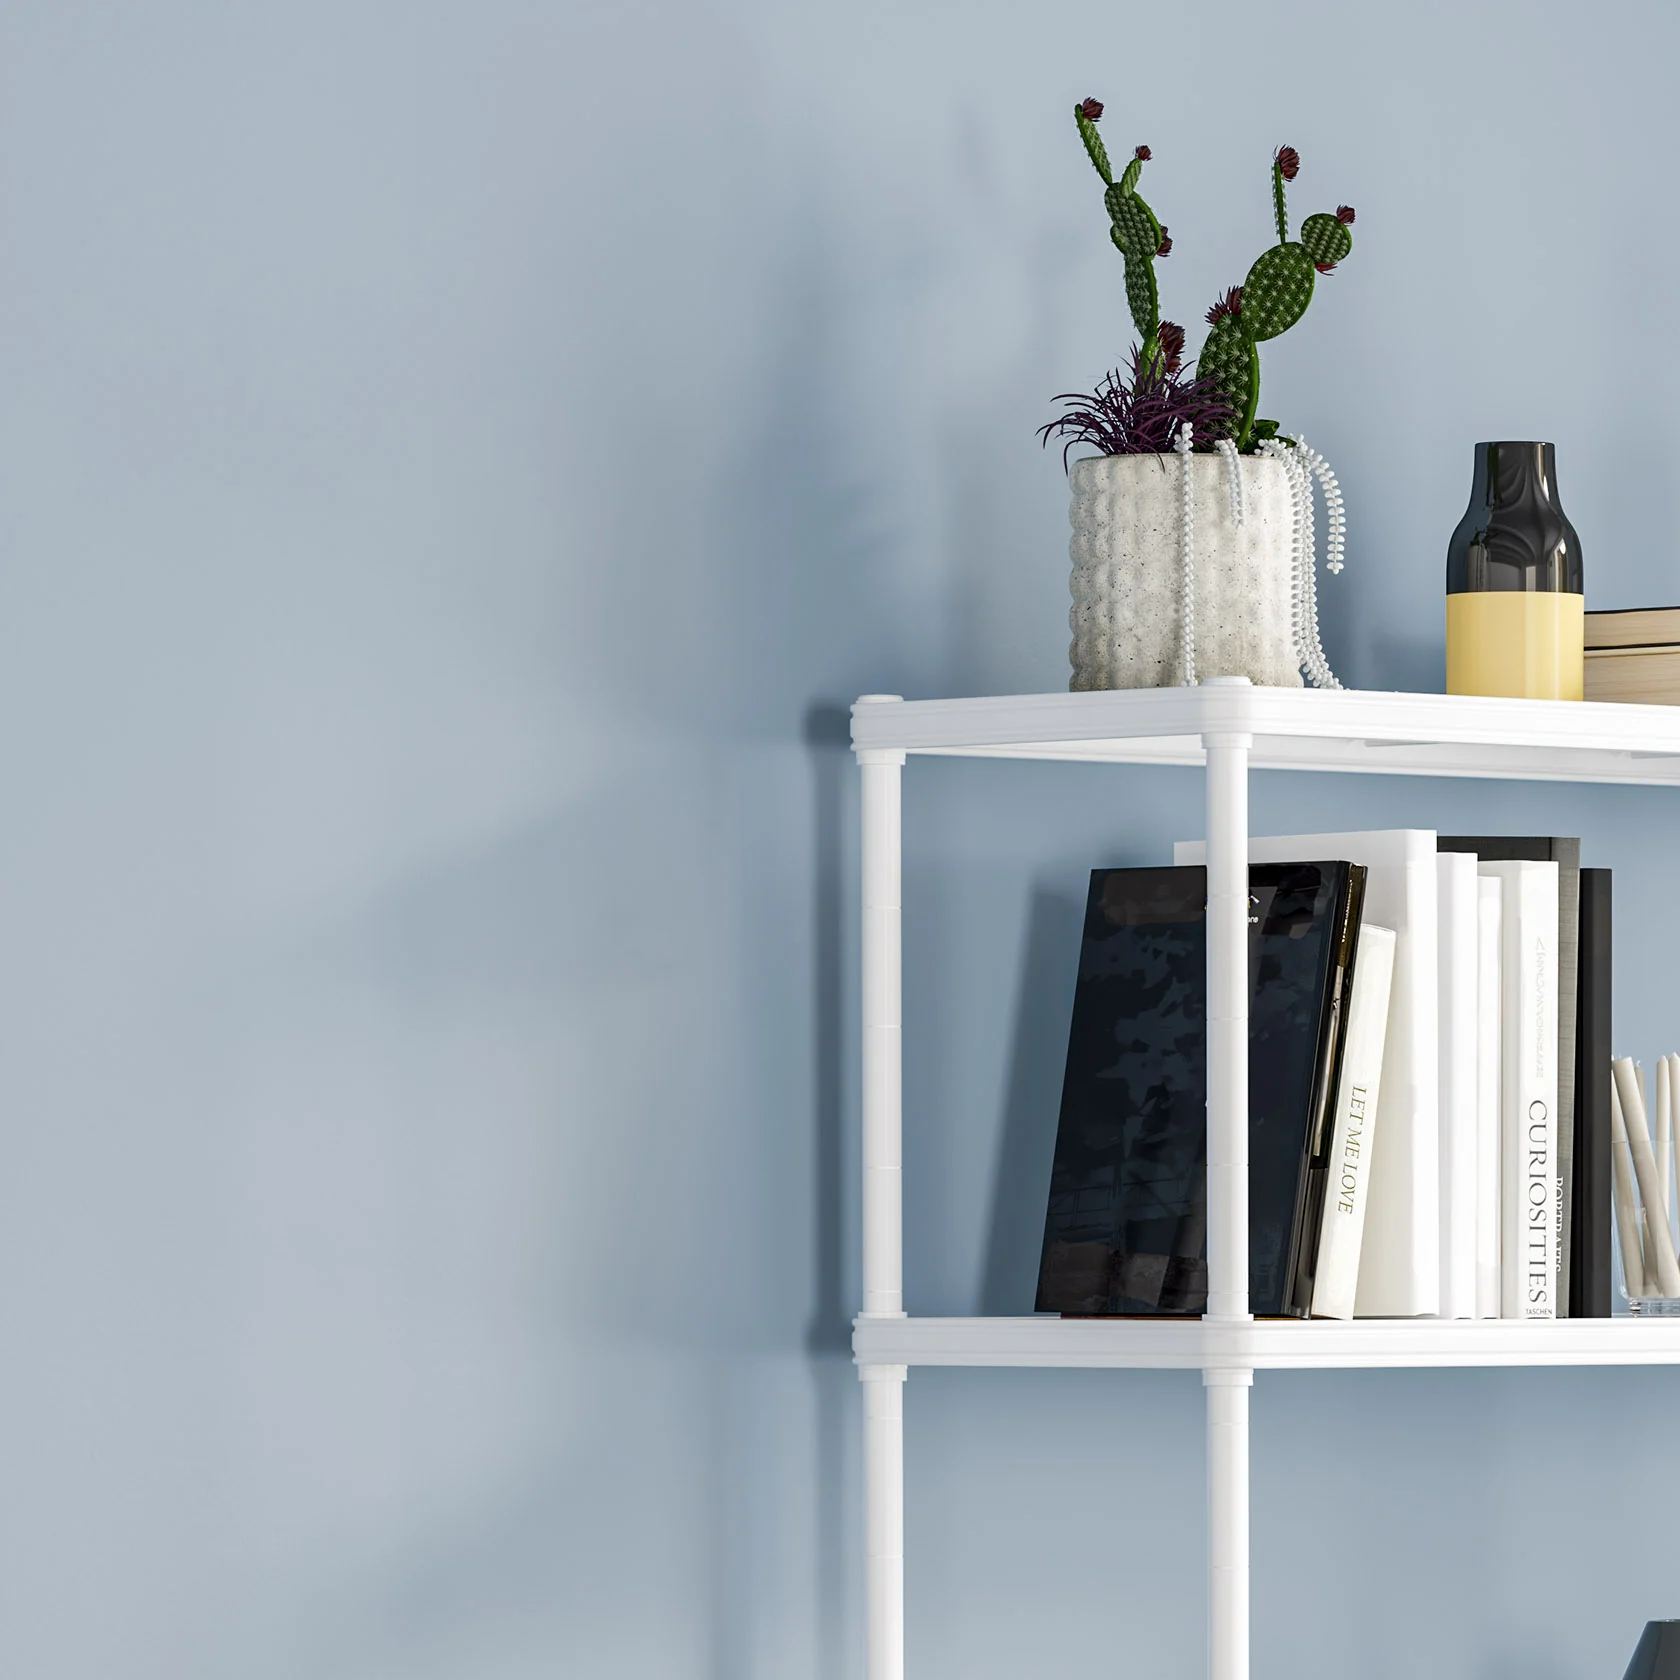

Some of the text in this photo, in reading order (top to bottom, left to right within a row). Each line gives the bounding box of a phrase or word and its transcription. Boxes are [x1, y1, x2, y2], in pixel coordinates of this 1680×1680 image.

[1338, 1086, 1367, 1215] LET ME LOVE
[1528, 1100, 1548, 1303] CURIOSITIES
